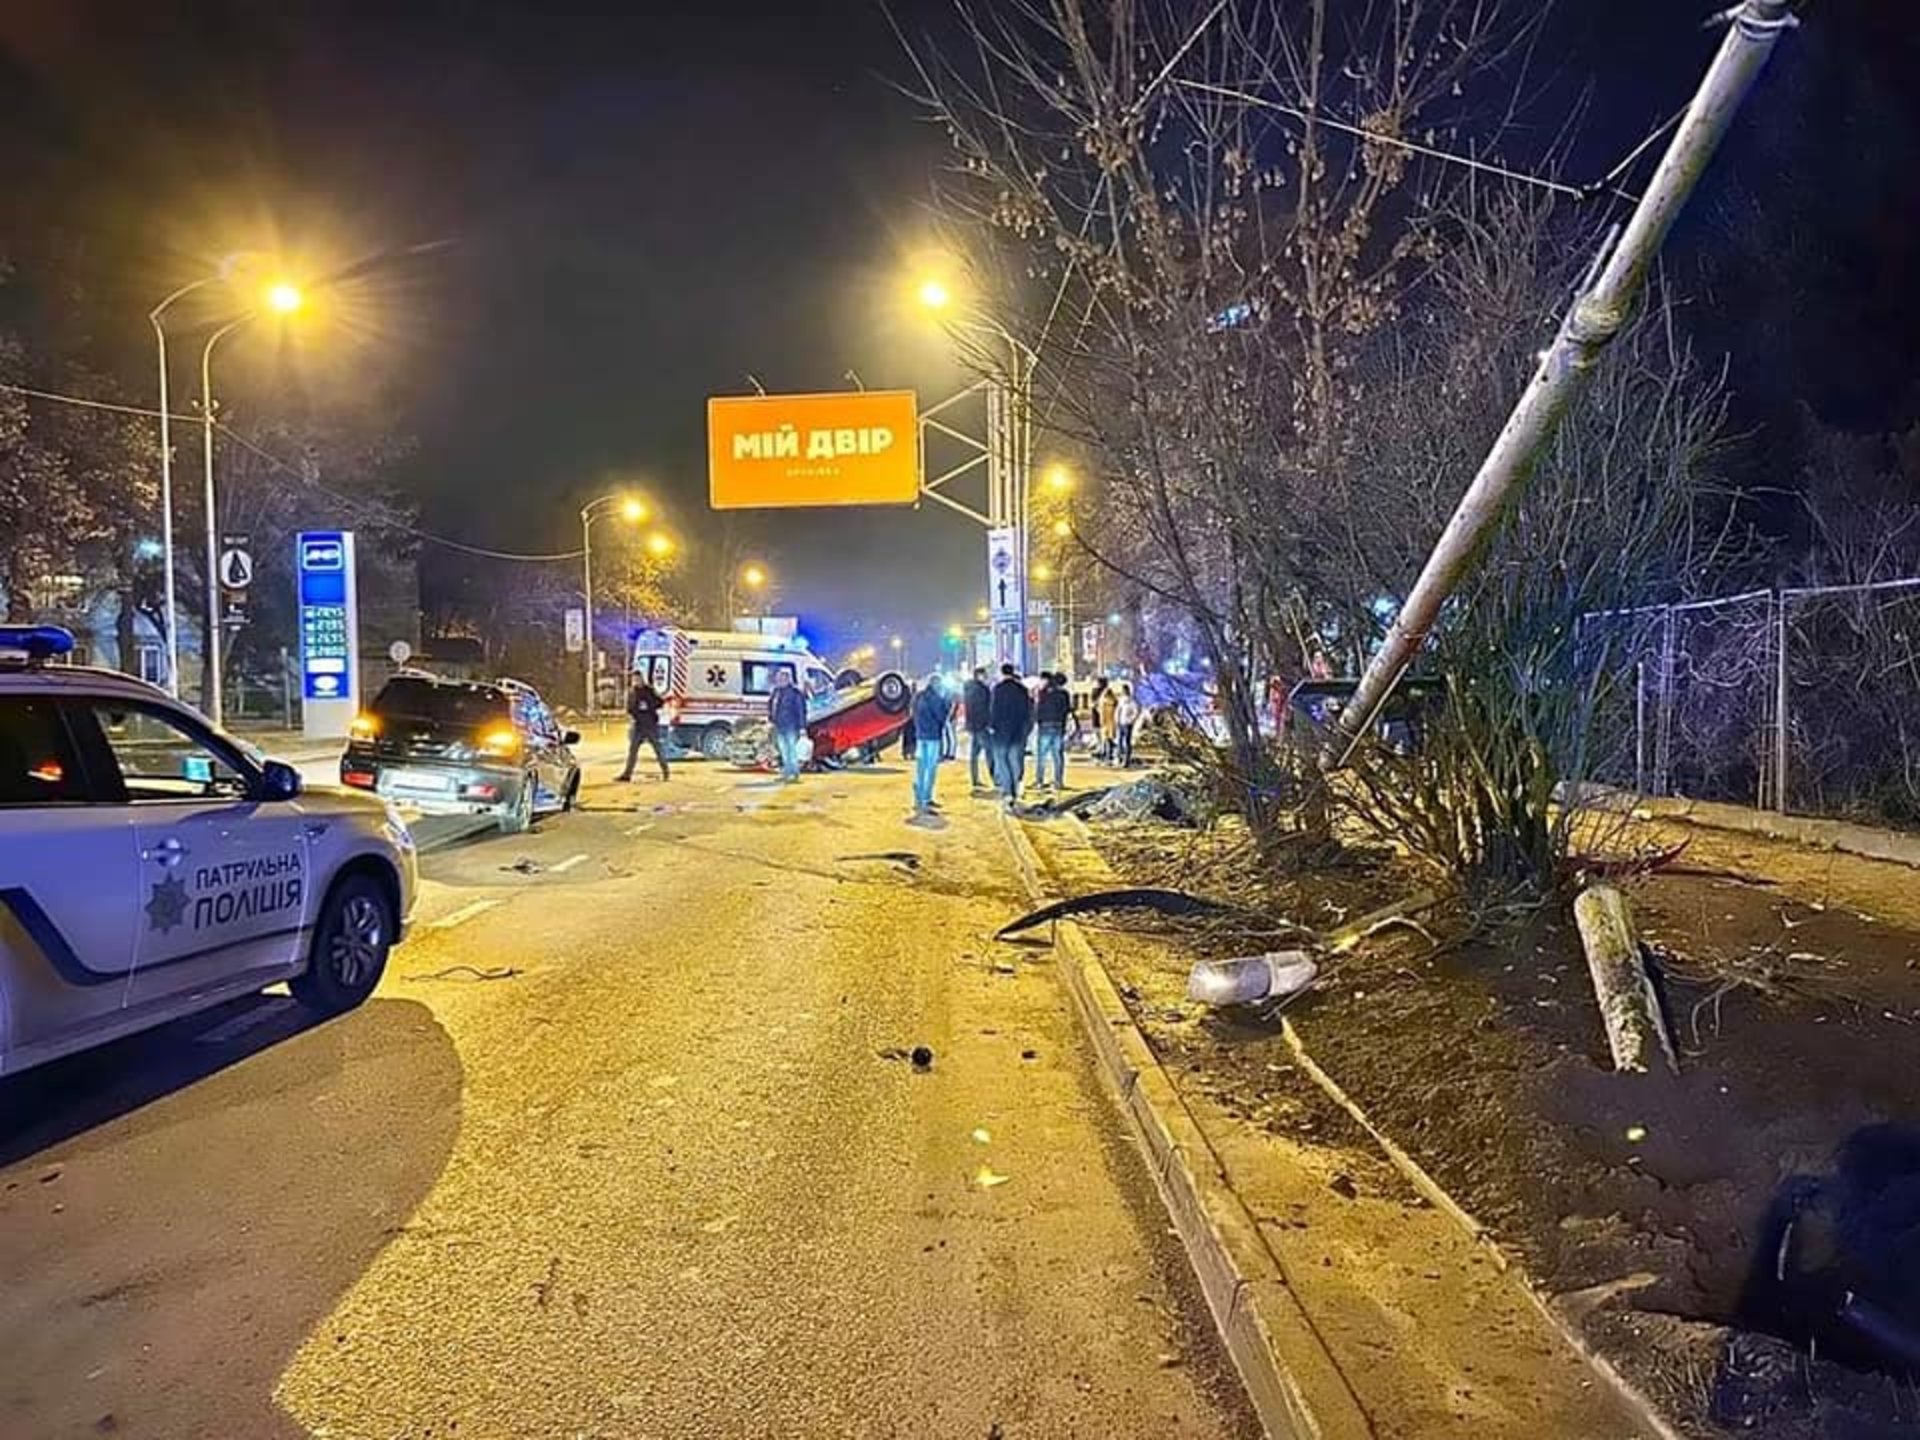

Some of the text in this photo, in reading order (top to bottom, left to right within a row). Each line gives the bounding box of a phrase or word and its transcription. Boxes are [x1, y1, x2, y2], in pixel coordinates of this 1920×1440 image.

[733, 424, 894, 460] МІЙ ДВІР
[195, 852, 302, 890] ПАТРУЛЬНА
[194, 878, 302, 931] ПОЛІЦІЯ
